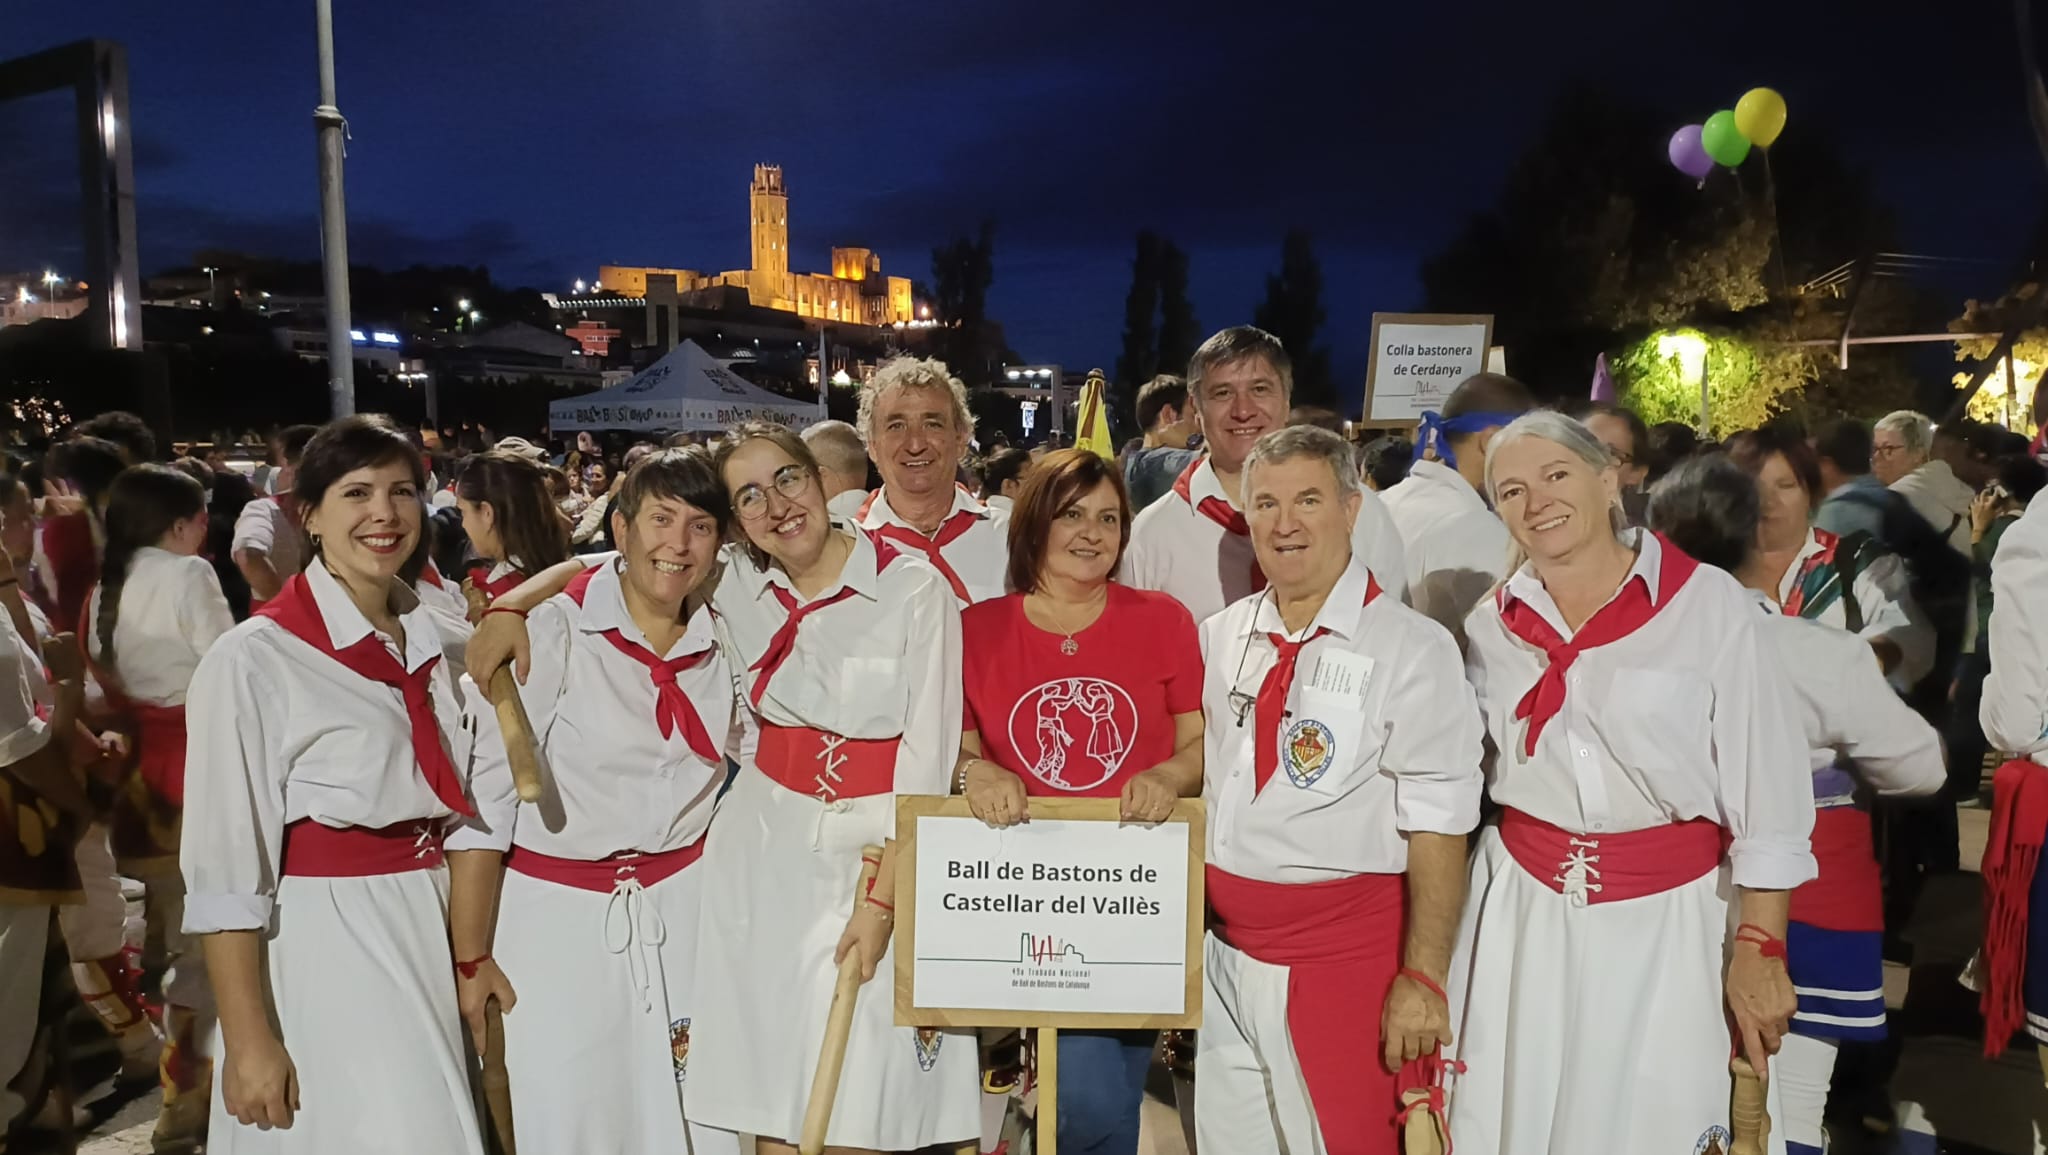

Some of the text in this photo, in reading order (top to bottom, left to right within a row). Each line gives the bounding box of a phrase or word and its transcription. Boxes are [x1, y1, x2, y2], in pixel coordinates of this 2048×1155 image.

[1386, 344, 1473, 356] Colla bastonera
[1393, 364, 1462, 378] de Cerdanya
[948, 860, 1157, 883] Ball de Bastons de
[942, 893, 1160, 916] Castellar del Vallès
